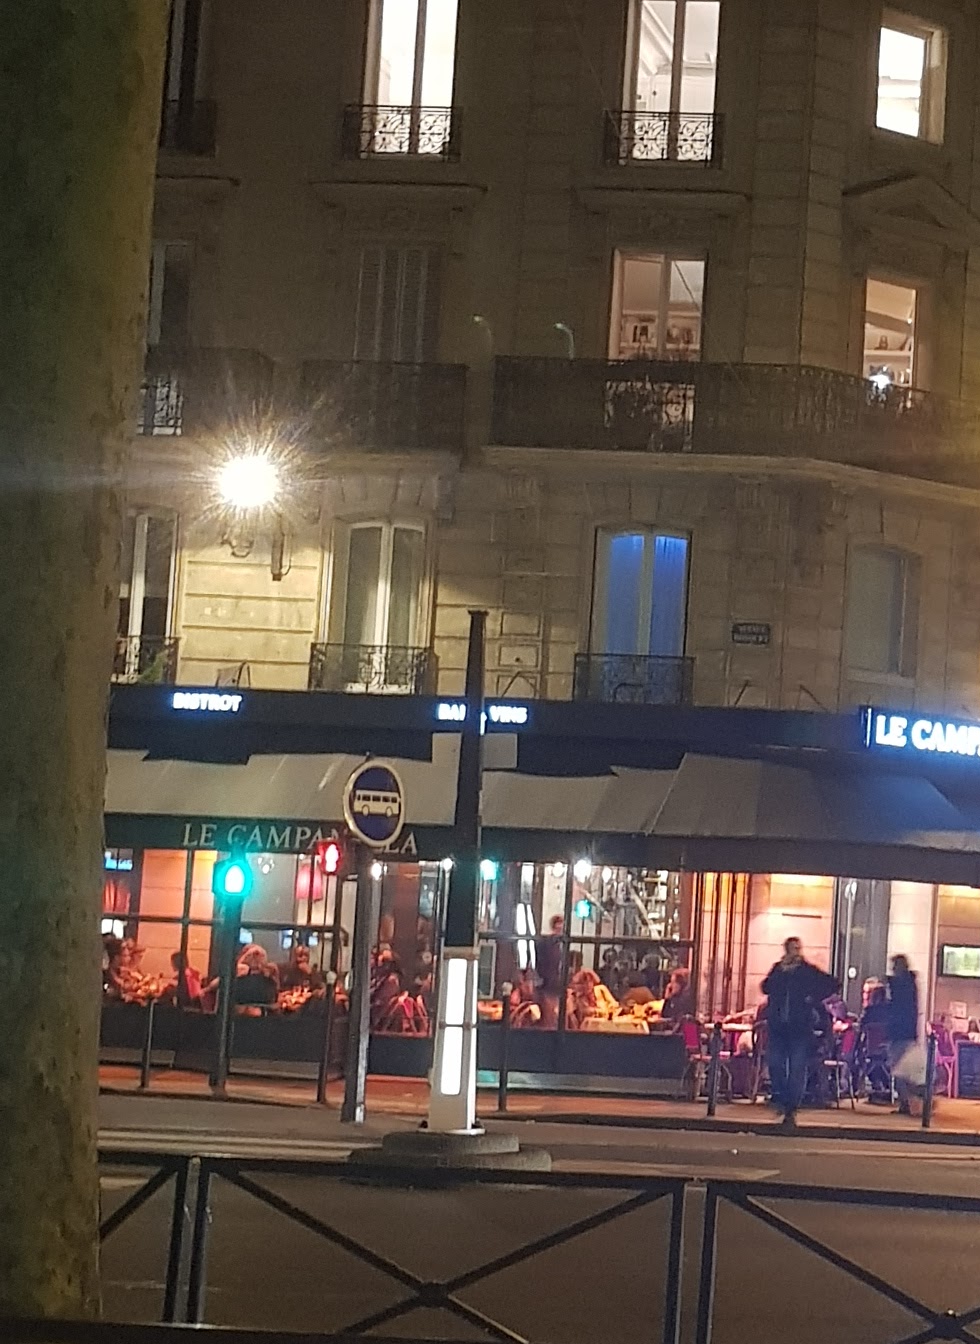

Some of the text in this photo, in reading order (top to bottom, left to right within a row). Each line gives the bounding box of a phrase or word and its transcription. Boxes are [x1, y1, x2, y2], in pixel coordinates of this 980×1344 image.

[173, 692, 243, 712] BISTROT
[489, 705, 528, 724] VINS
[874, 714, 908, 748] LE
[183, 823, 418, 855] LE CAMPALA
